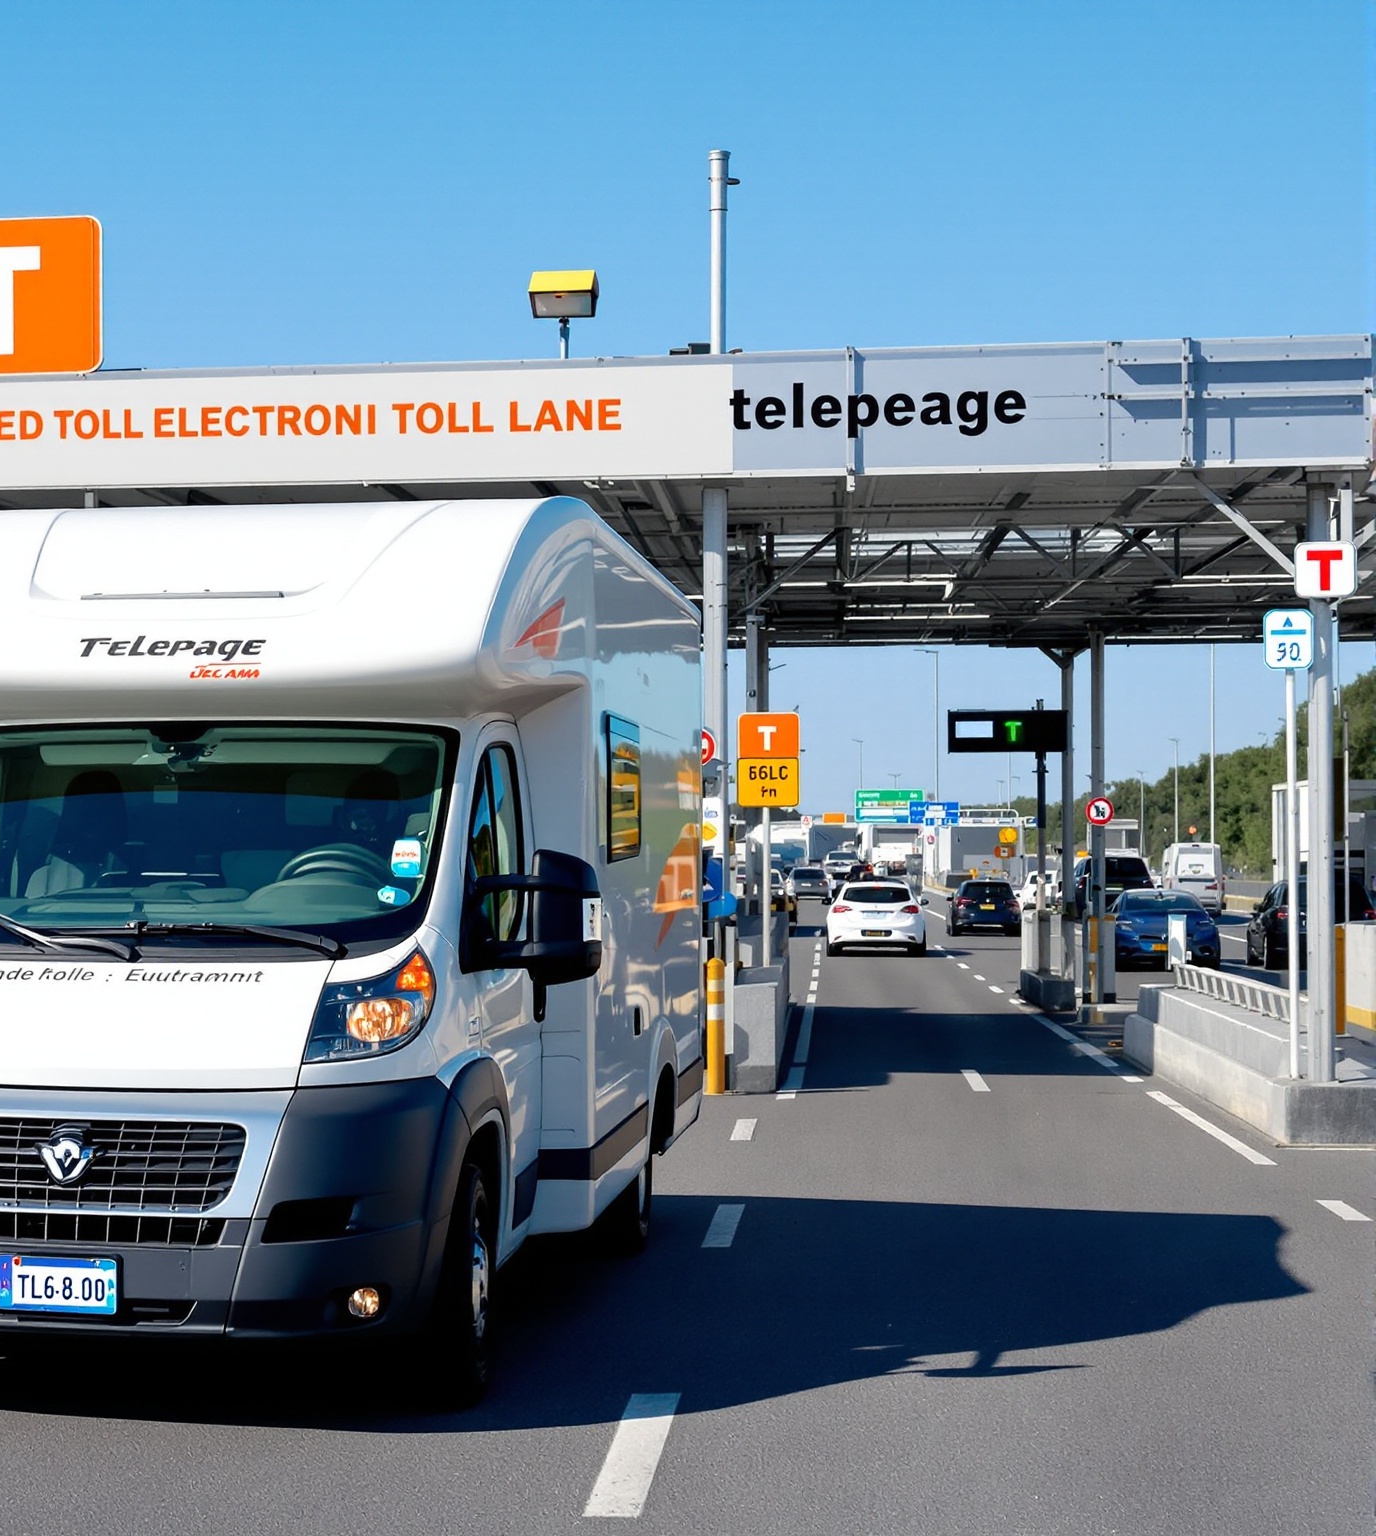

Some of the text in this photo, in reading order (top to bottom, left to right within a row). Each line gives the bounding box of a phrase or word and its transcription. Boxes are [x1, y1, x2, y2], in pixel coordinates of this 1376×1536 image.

[53, 408, 144, 440] TOLL
[154, 404, 376, 438] ELECTRONI
[392, 401, 494, 434] TOLL
[509, 398, 622, 432] LANE
[729, 382, 1027, 438] telepeage
[1306, 550, 1343, 591] T
[757, 725, 777, 751] T
[1004, 721, 1022, 742] T
